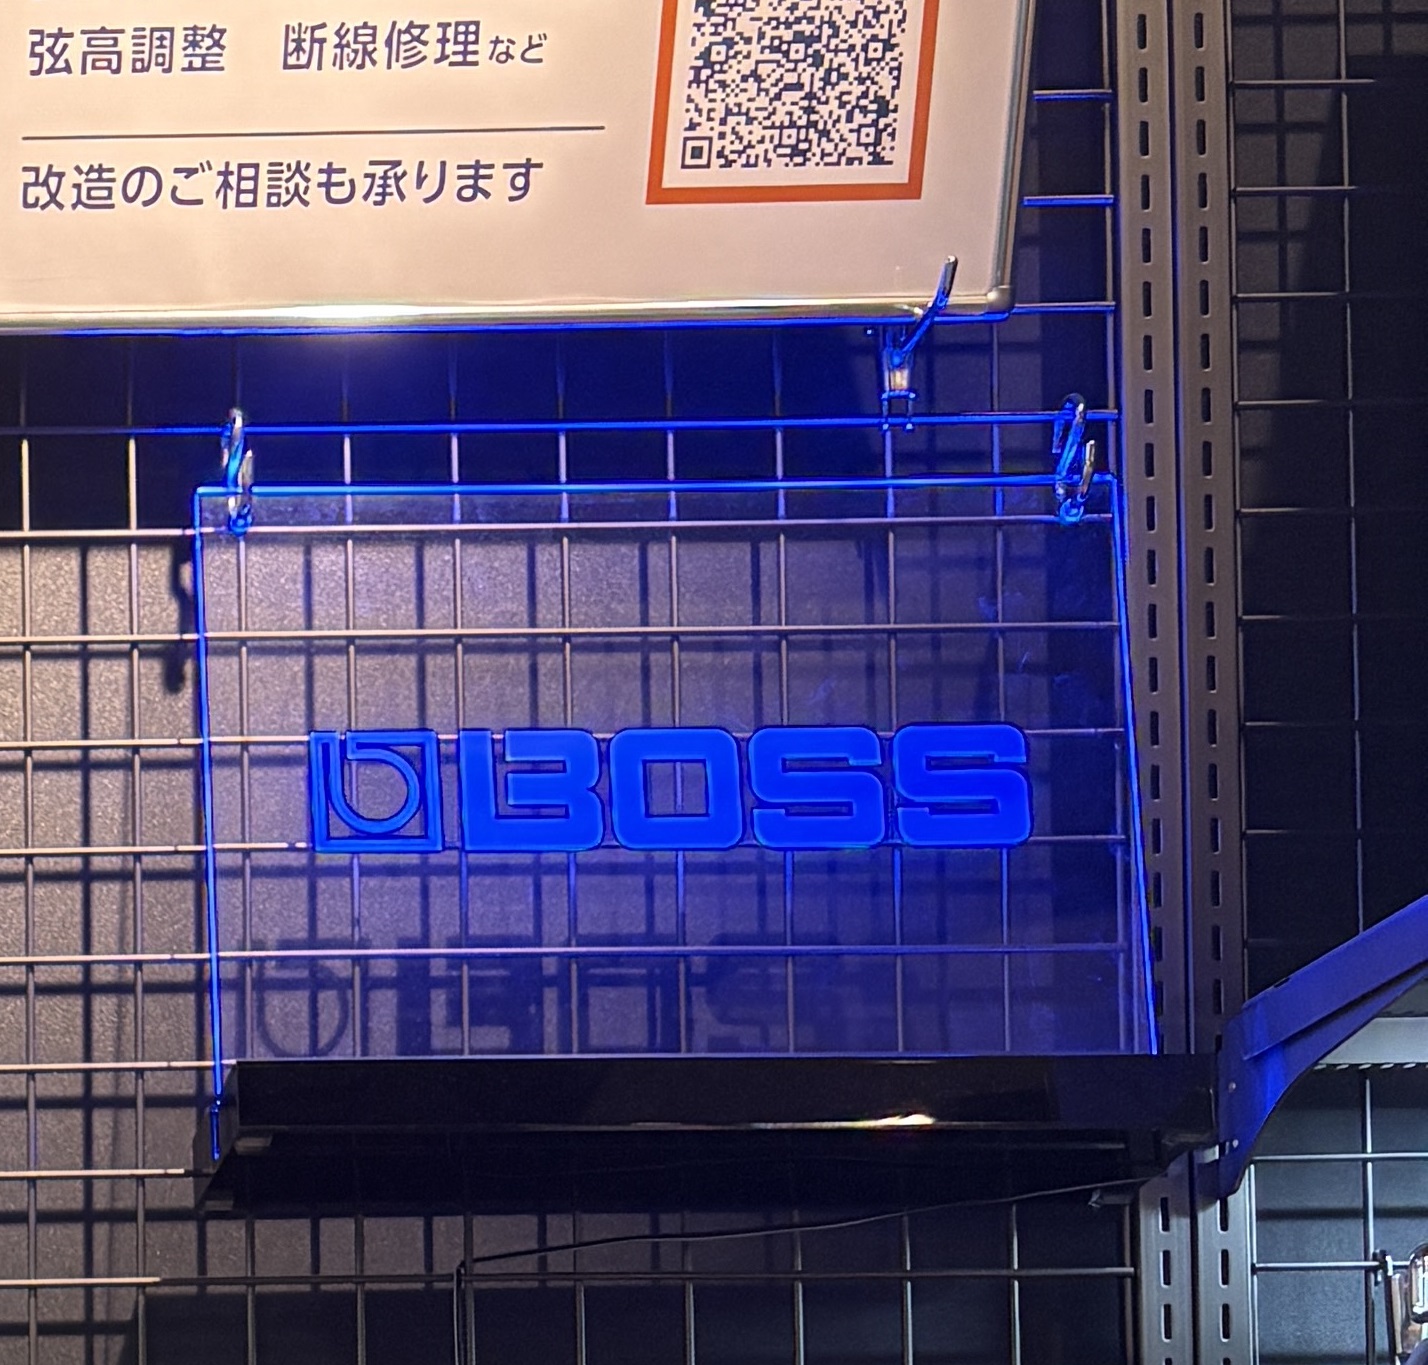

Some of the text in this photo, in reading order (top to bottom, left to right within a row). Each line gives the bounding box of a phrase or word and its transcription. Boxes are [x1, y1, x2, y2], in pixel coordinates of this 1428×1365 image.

[28, 20, 548, 77] 弦高調整 断線修理など
[21, 157, 544, 211] 改造のご相談も承ります
[459, 722, 1034, 852] BOSS
